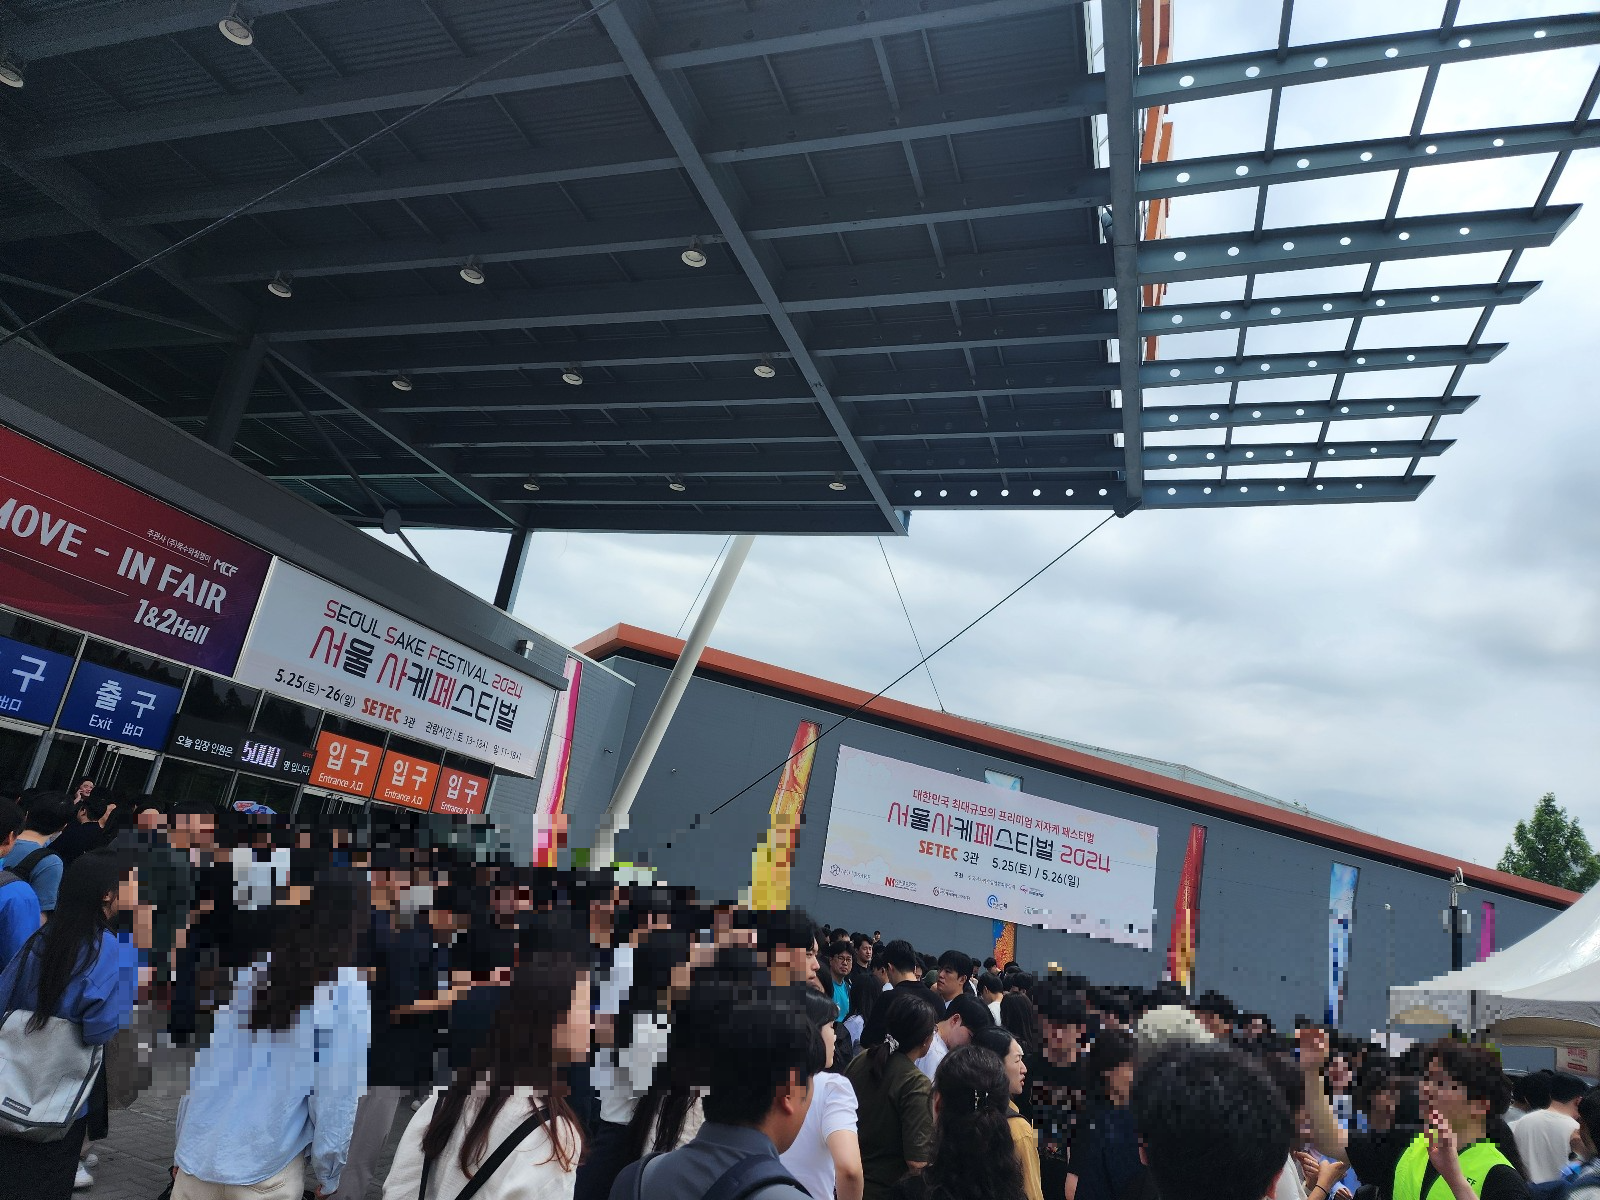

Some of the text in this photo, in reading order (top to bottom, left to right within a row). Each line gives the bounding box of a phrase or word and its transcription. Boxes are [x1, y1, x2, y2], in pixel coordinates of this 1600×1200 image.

[117, 546, 156, 586] IN
[157, 563, 227, 614] FAIR
[133, 598, 211, 645] 1&2Hall
[323, 599, 524, 700] SEOUL SAKE FESTIVAL 2024
[309, 625, 519, 734] 서울 사케페스티벌
[88, 713, 114, 731] Exit
[361, 697, 402, 724] SETEC
[121, 722, 145, 738] 出口
[175, 735, 234, 758] 오늘 입장 인원은
[241, 740, 281, 769] 5000
[317, 772, 350, 790] Entrance
[384, 788, 411, 803] Entrance
[912, 789, 1096, 845] 대한민국 최대규모의 프리미엄 지자케 페스티벌
[887, 801, 1111, 874] 서울사케페스티벌 2024
[918, 839, 959, 861] SETEC
[962, 851, 980, 866] 3관
[991, 856, 1033, 877] 5.25(토)
[1042, 869, 1081, 889] 5.26(일)
